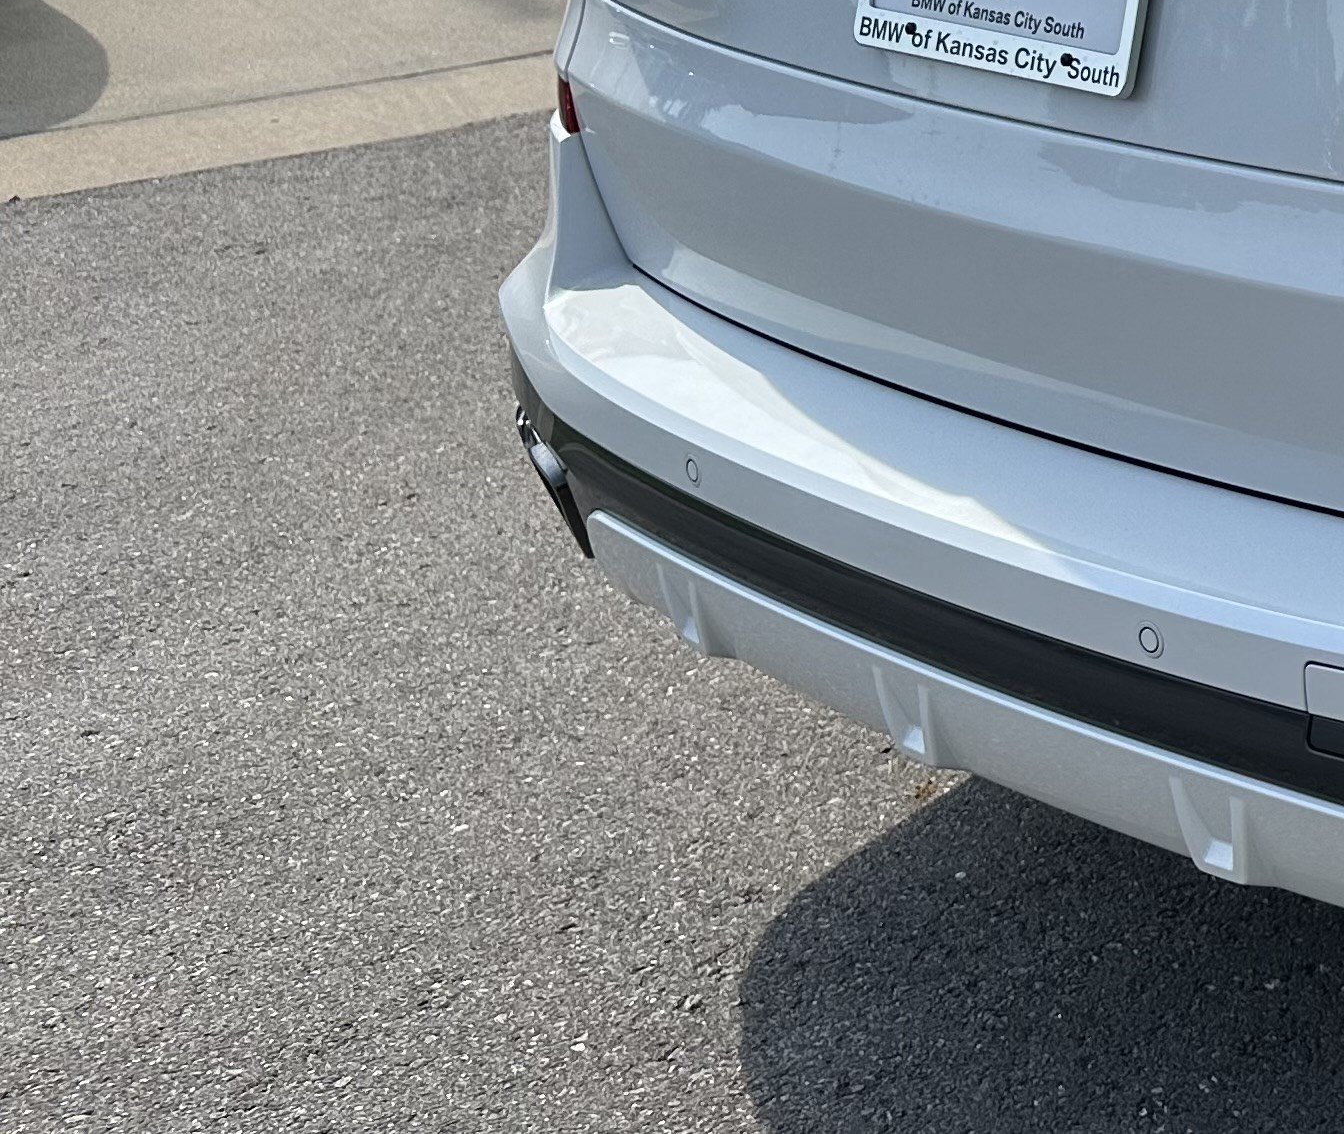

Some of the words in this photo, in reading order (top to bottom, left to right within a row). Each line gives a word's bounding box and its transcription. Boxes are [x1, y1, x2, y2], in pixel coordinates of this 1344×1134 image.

[963, 4, 1011, 26] Kansas
[1014, 11, 1041, 34] City
[1044, 16, 1085, 40] South
[859, 16, 905, 44] BMW
[911, 29, 933, 49] of
[935, 32, 1009, 66] Kansas
[1014, 47, 1057, 79] City
[1067, 57, 1121, 88] South
